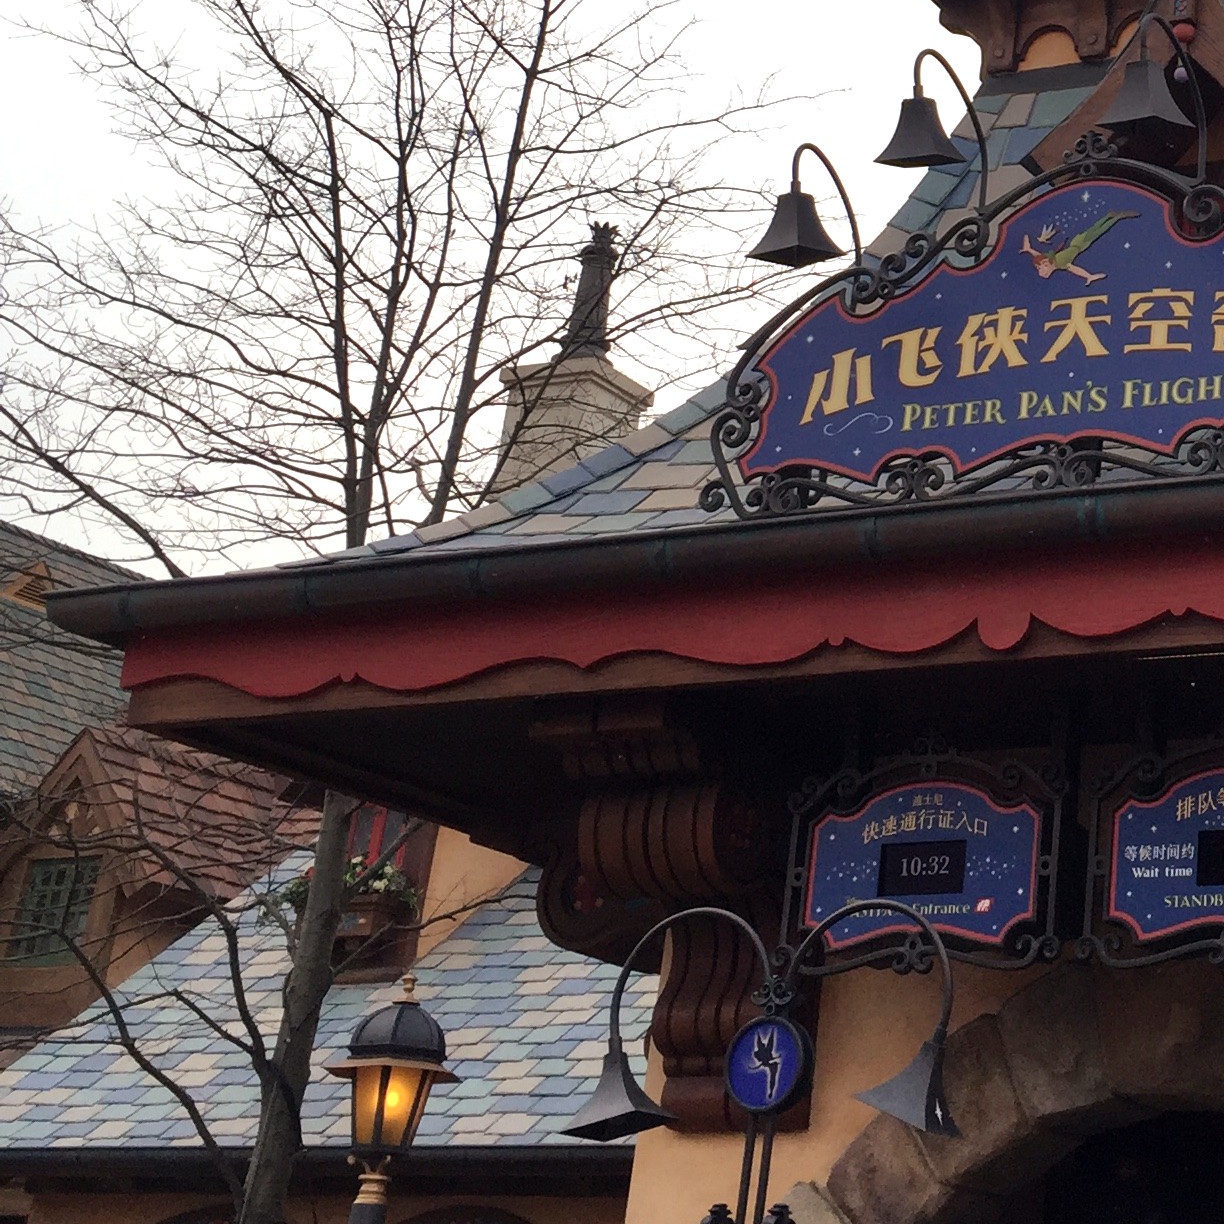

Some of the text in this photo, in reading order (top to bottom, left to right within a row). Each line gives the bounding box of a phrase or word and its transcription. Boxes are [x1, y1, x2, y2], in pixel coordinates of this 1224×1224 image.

[901, 397, 1004, 431] PETER
[862, 809, 988, 844] 快速通行证入口
[1124, 842, 1195, 862] 等候时间约
[900, 856, 950, 877] 10:32
[1131, 865, 1194, 878] Wait time
